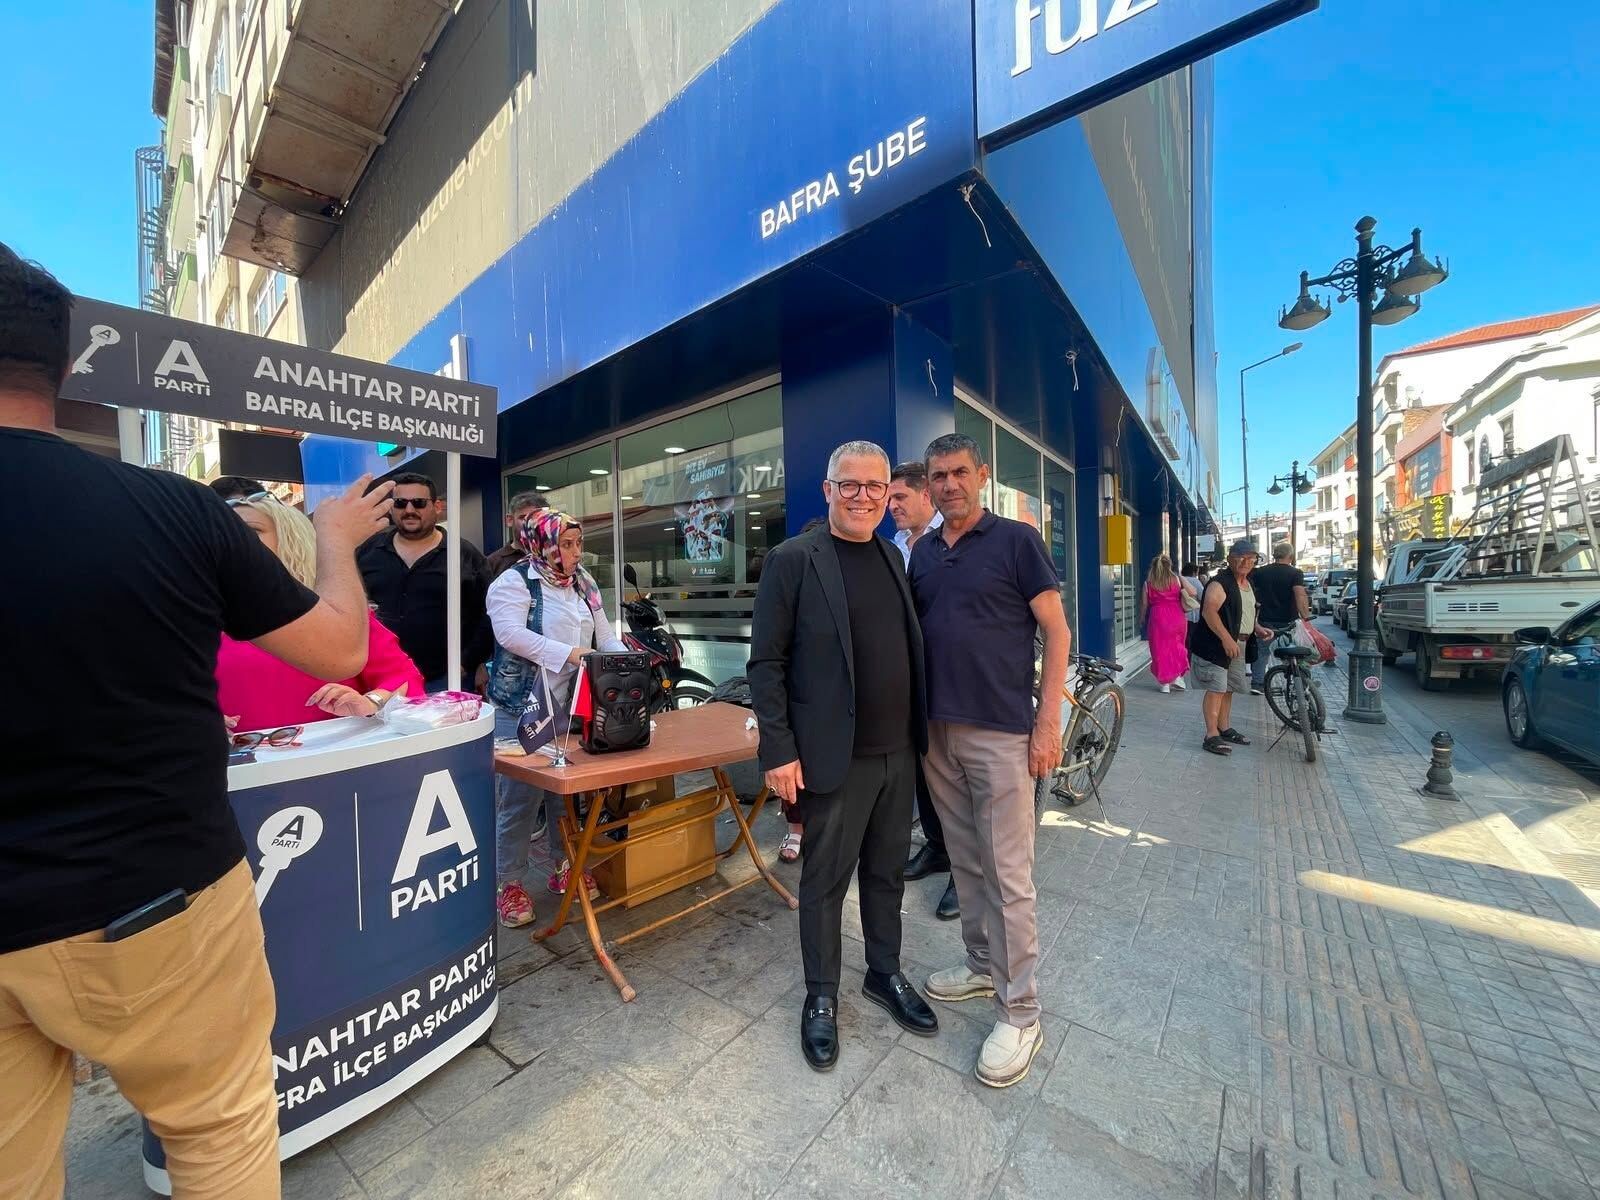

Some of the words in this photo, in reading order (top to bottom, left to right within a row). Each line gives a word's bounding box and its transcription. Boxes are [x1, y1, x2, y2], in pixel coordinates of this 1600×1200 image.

[761, 172, 841, 239] BAFRA
[848, 116, 928, 195] ŞUBE
[153, 374, 211, 397] PARTİ
[253, 355, 403, 405] ANAHTAR
[410, 388, 481, 418] PARTİ
[245, 391, 325, 421] BAFRA
[330, 401, 373, 430] İLÇE
[378, 413, 485, 445] BAŞKANLIĞI
[271, 838, 301, 849] PARTİ
[391, 769, 478, 884] A
[391, 855, 479, 919] PARTİ
[271, 988, 421, 1080] NAHTAR
[429, 934, 493, 1001] PARTİ
[277, 1075, 327, 1110] FRA
[333, 1050, 387, 1086] İLÇE
[393, 965, 496, 1055] BAŞKANLIĞI
